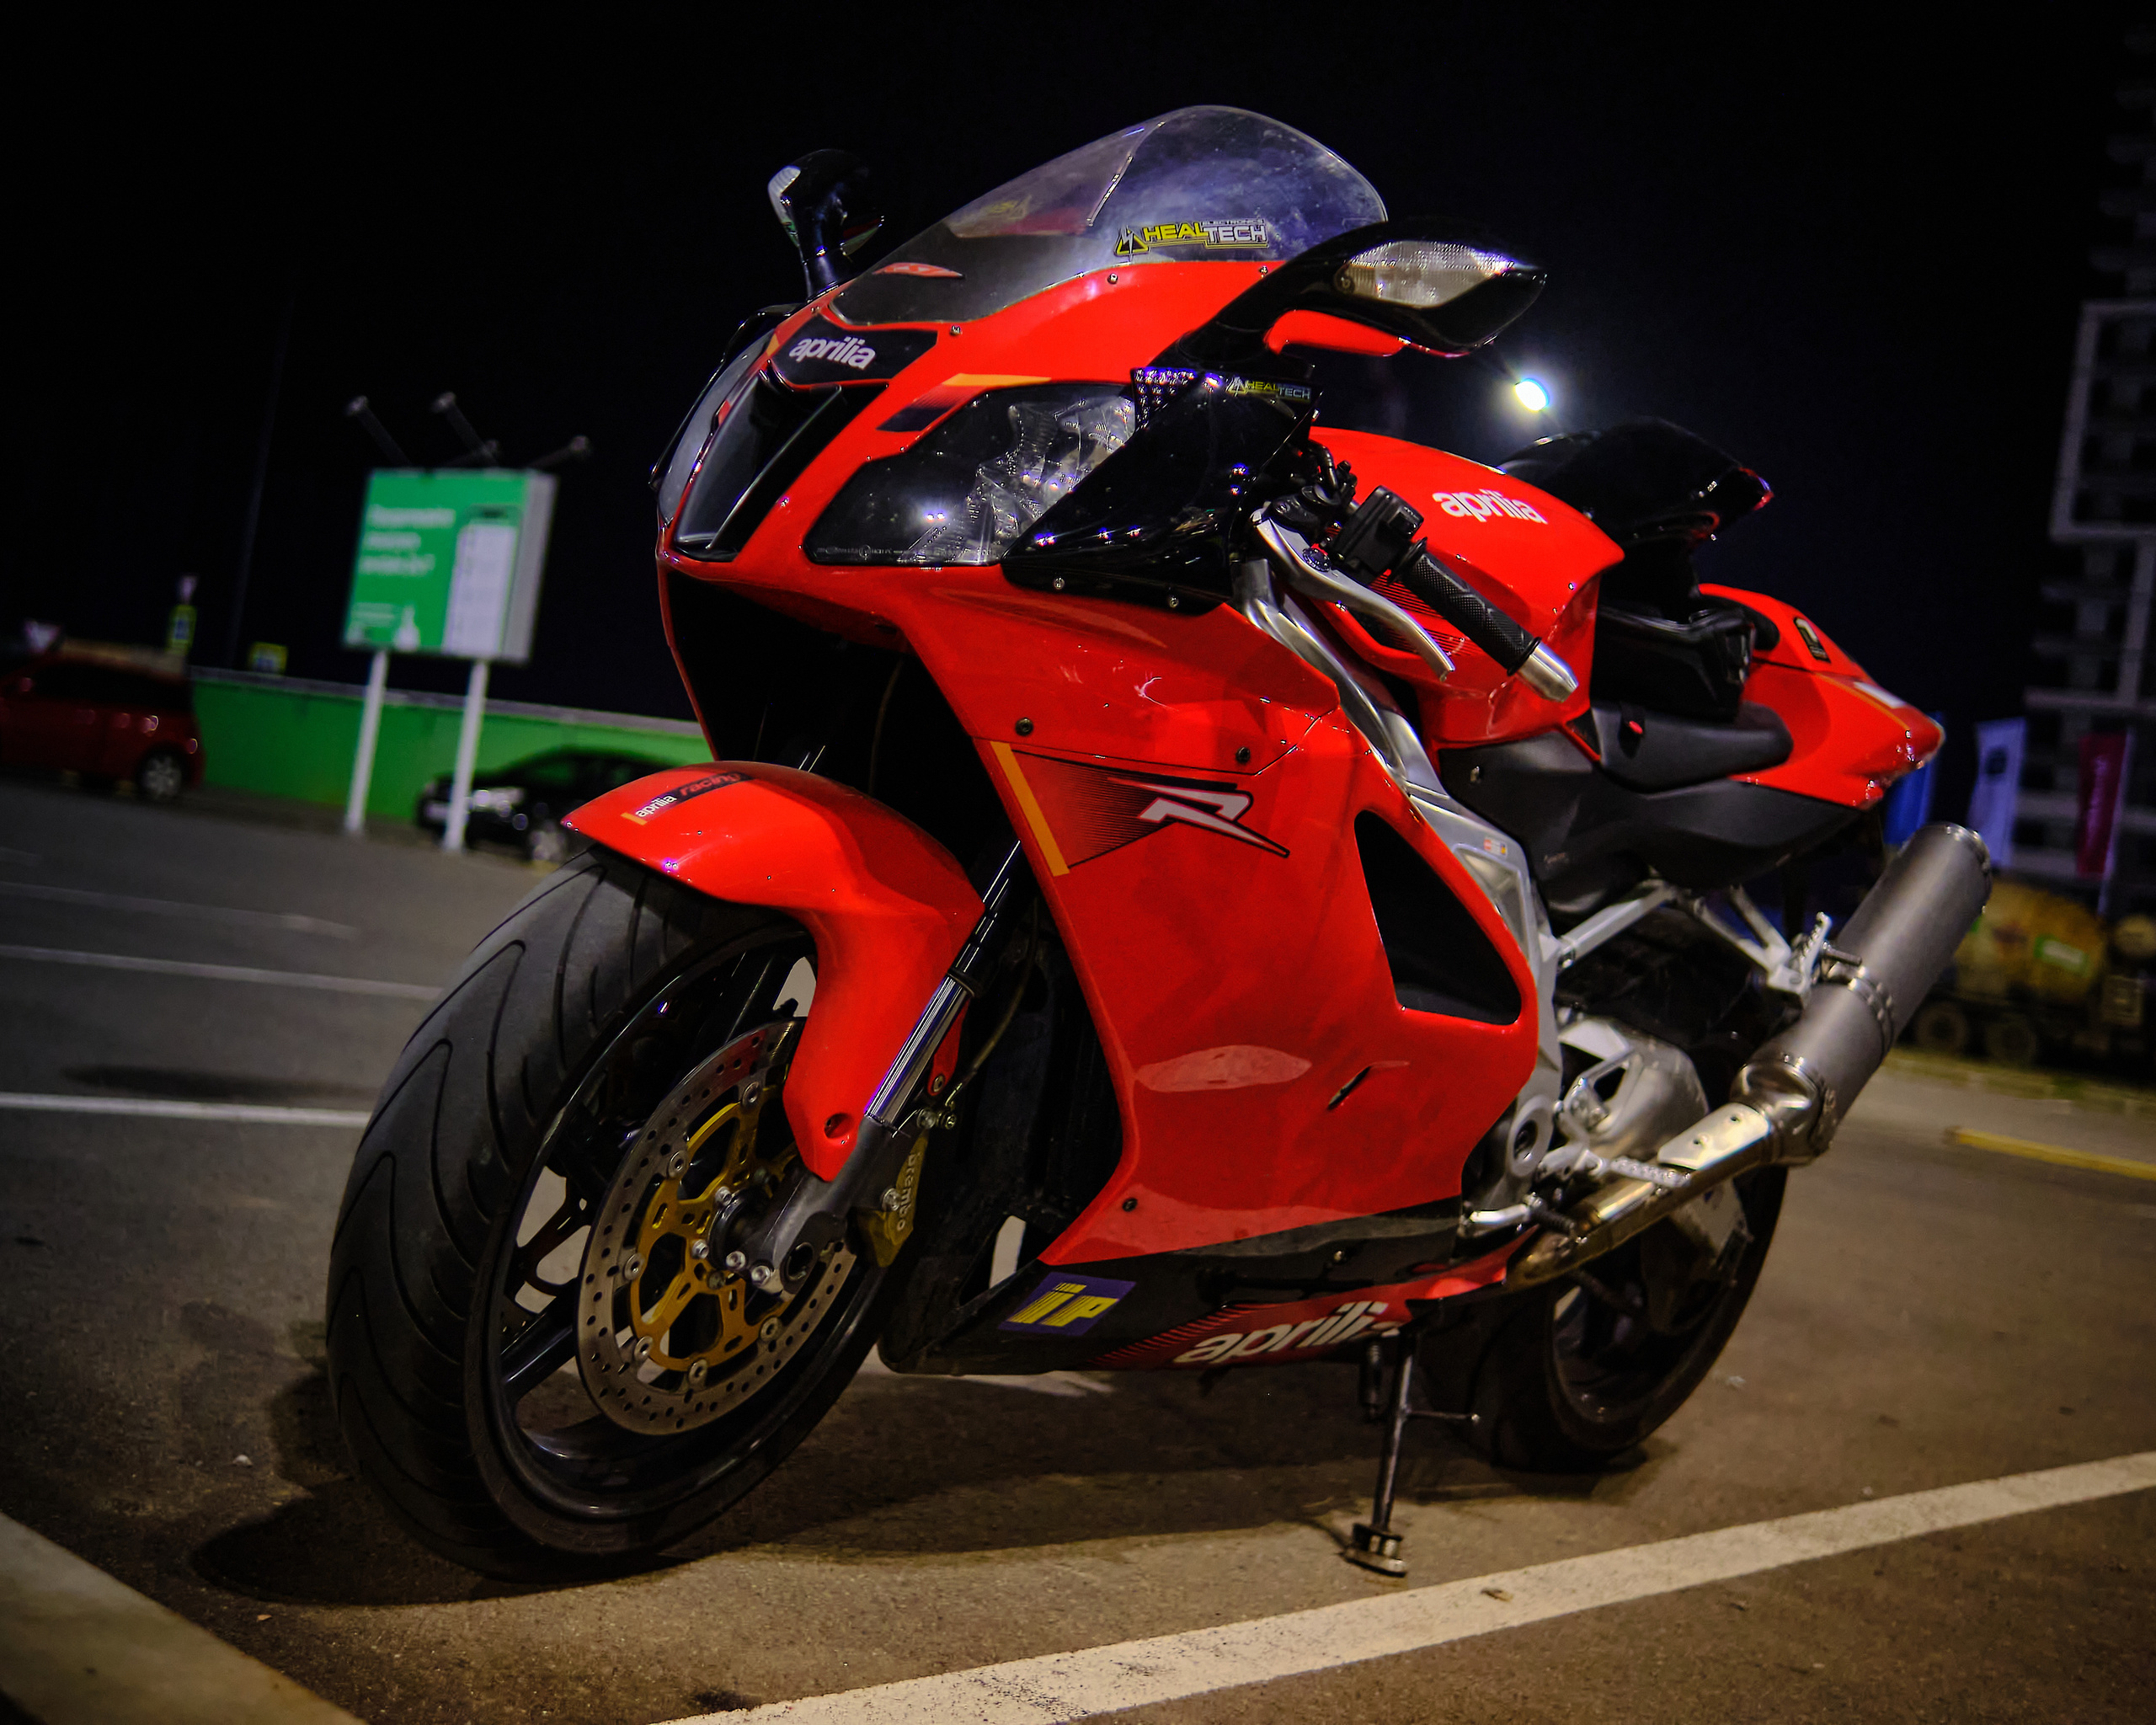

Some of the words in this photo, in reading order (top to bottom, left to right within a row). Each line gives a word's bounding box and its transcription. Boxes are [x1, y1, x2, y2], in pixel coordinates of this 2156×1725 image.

[789, 336, 876, 371] aprilia
[1433, 489, 1548, 524] aprilia
[635, 794, 677, 817] aprilia
[680, 772, 741, 796] racing
[897, 1153, 921, 1231] brembo
